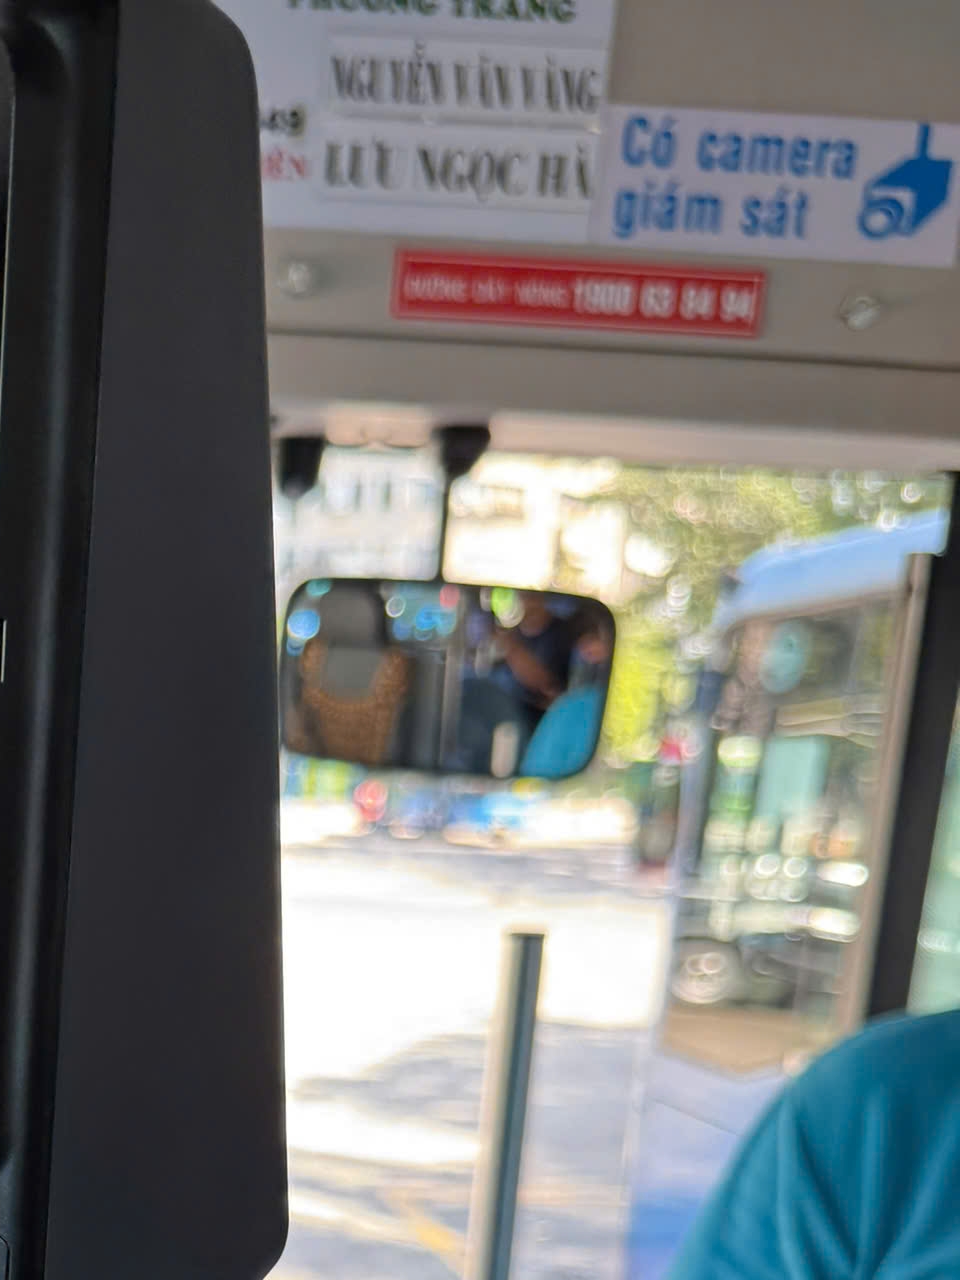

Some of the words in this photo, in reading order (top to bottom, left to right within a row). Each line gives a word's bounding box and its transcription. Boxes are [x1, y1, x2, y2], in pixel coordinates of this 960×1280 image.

[415, 143, 529, 202] NGỌC
[622, 114, 679, 169] Có
[696, 129, 858, 180] camera
[613, 177, 724, 239] giám
[741, 184, 810, 238] sát
